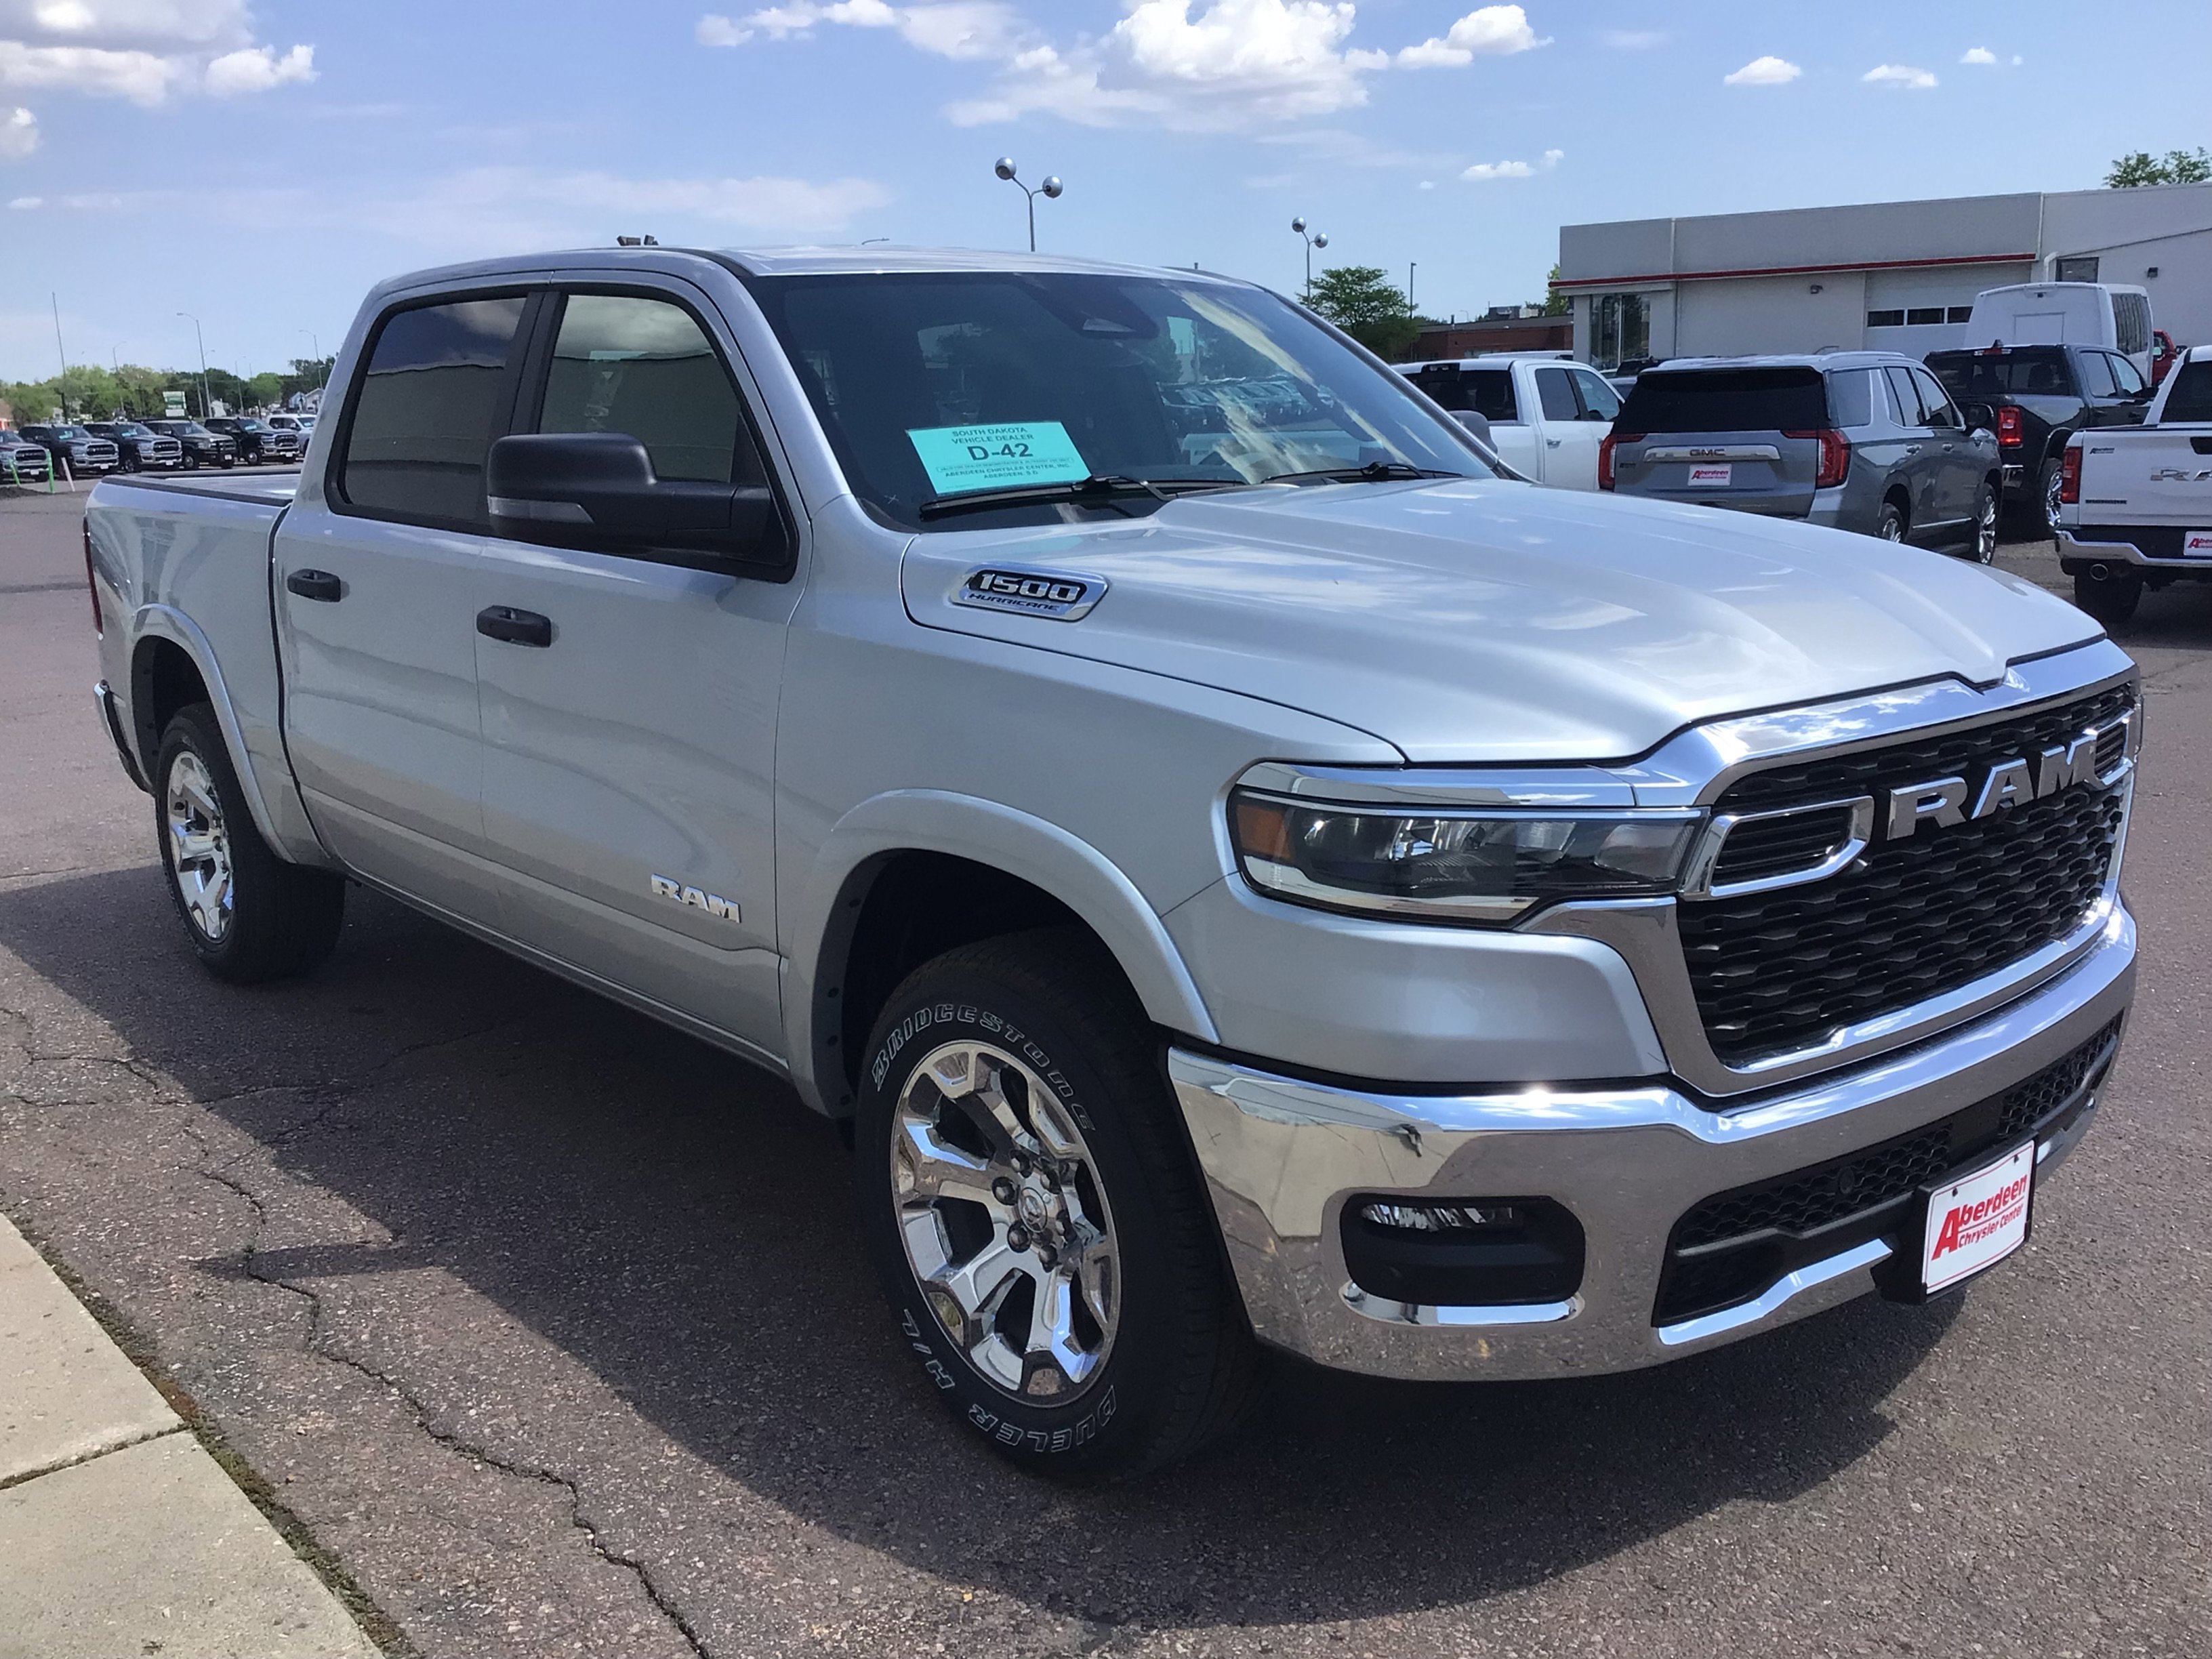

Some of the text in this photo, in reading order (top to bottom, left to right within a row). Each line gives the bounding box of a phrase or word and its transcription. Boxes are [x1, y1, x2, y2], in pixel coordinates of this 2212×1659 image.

[951, 429, 986, 437] SOUTH
[951, 434, 1035, 445] VEHICLE DEALER
[966, 443, 1033, 461] D-42
[1689, 449, 1726, 457] GMC
[945, 469, 985, 478] ABERDEEN
[968, 592, 1060, 611] HURRICANE
[979, 573, 1081, 602] 1500
[1887, 733, 2103, 840] RAM
[651, 873, 742, 924] RAM
[872, 1004, 1095, 1131] BRIDGESTONE
[1931, 1174, 2027, 1261] Aberdeen
[1958, 1204, 2023, 1248] Chrysler Center
[968, 1385, 1118, 1453] DUELER
